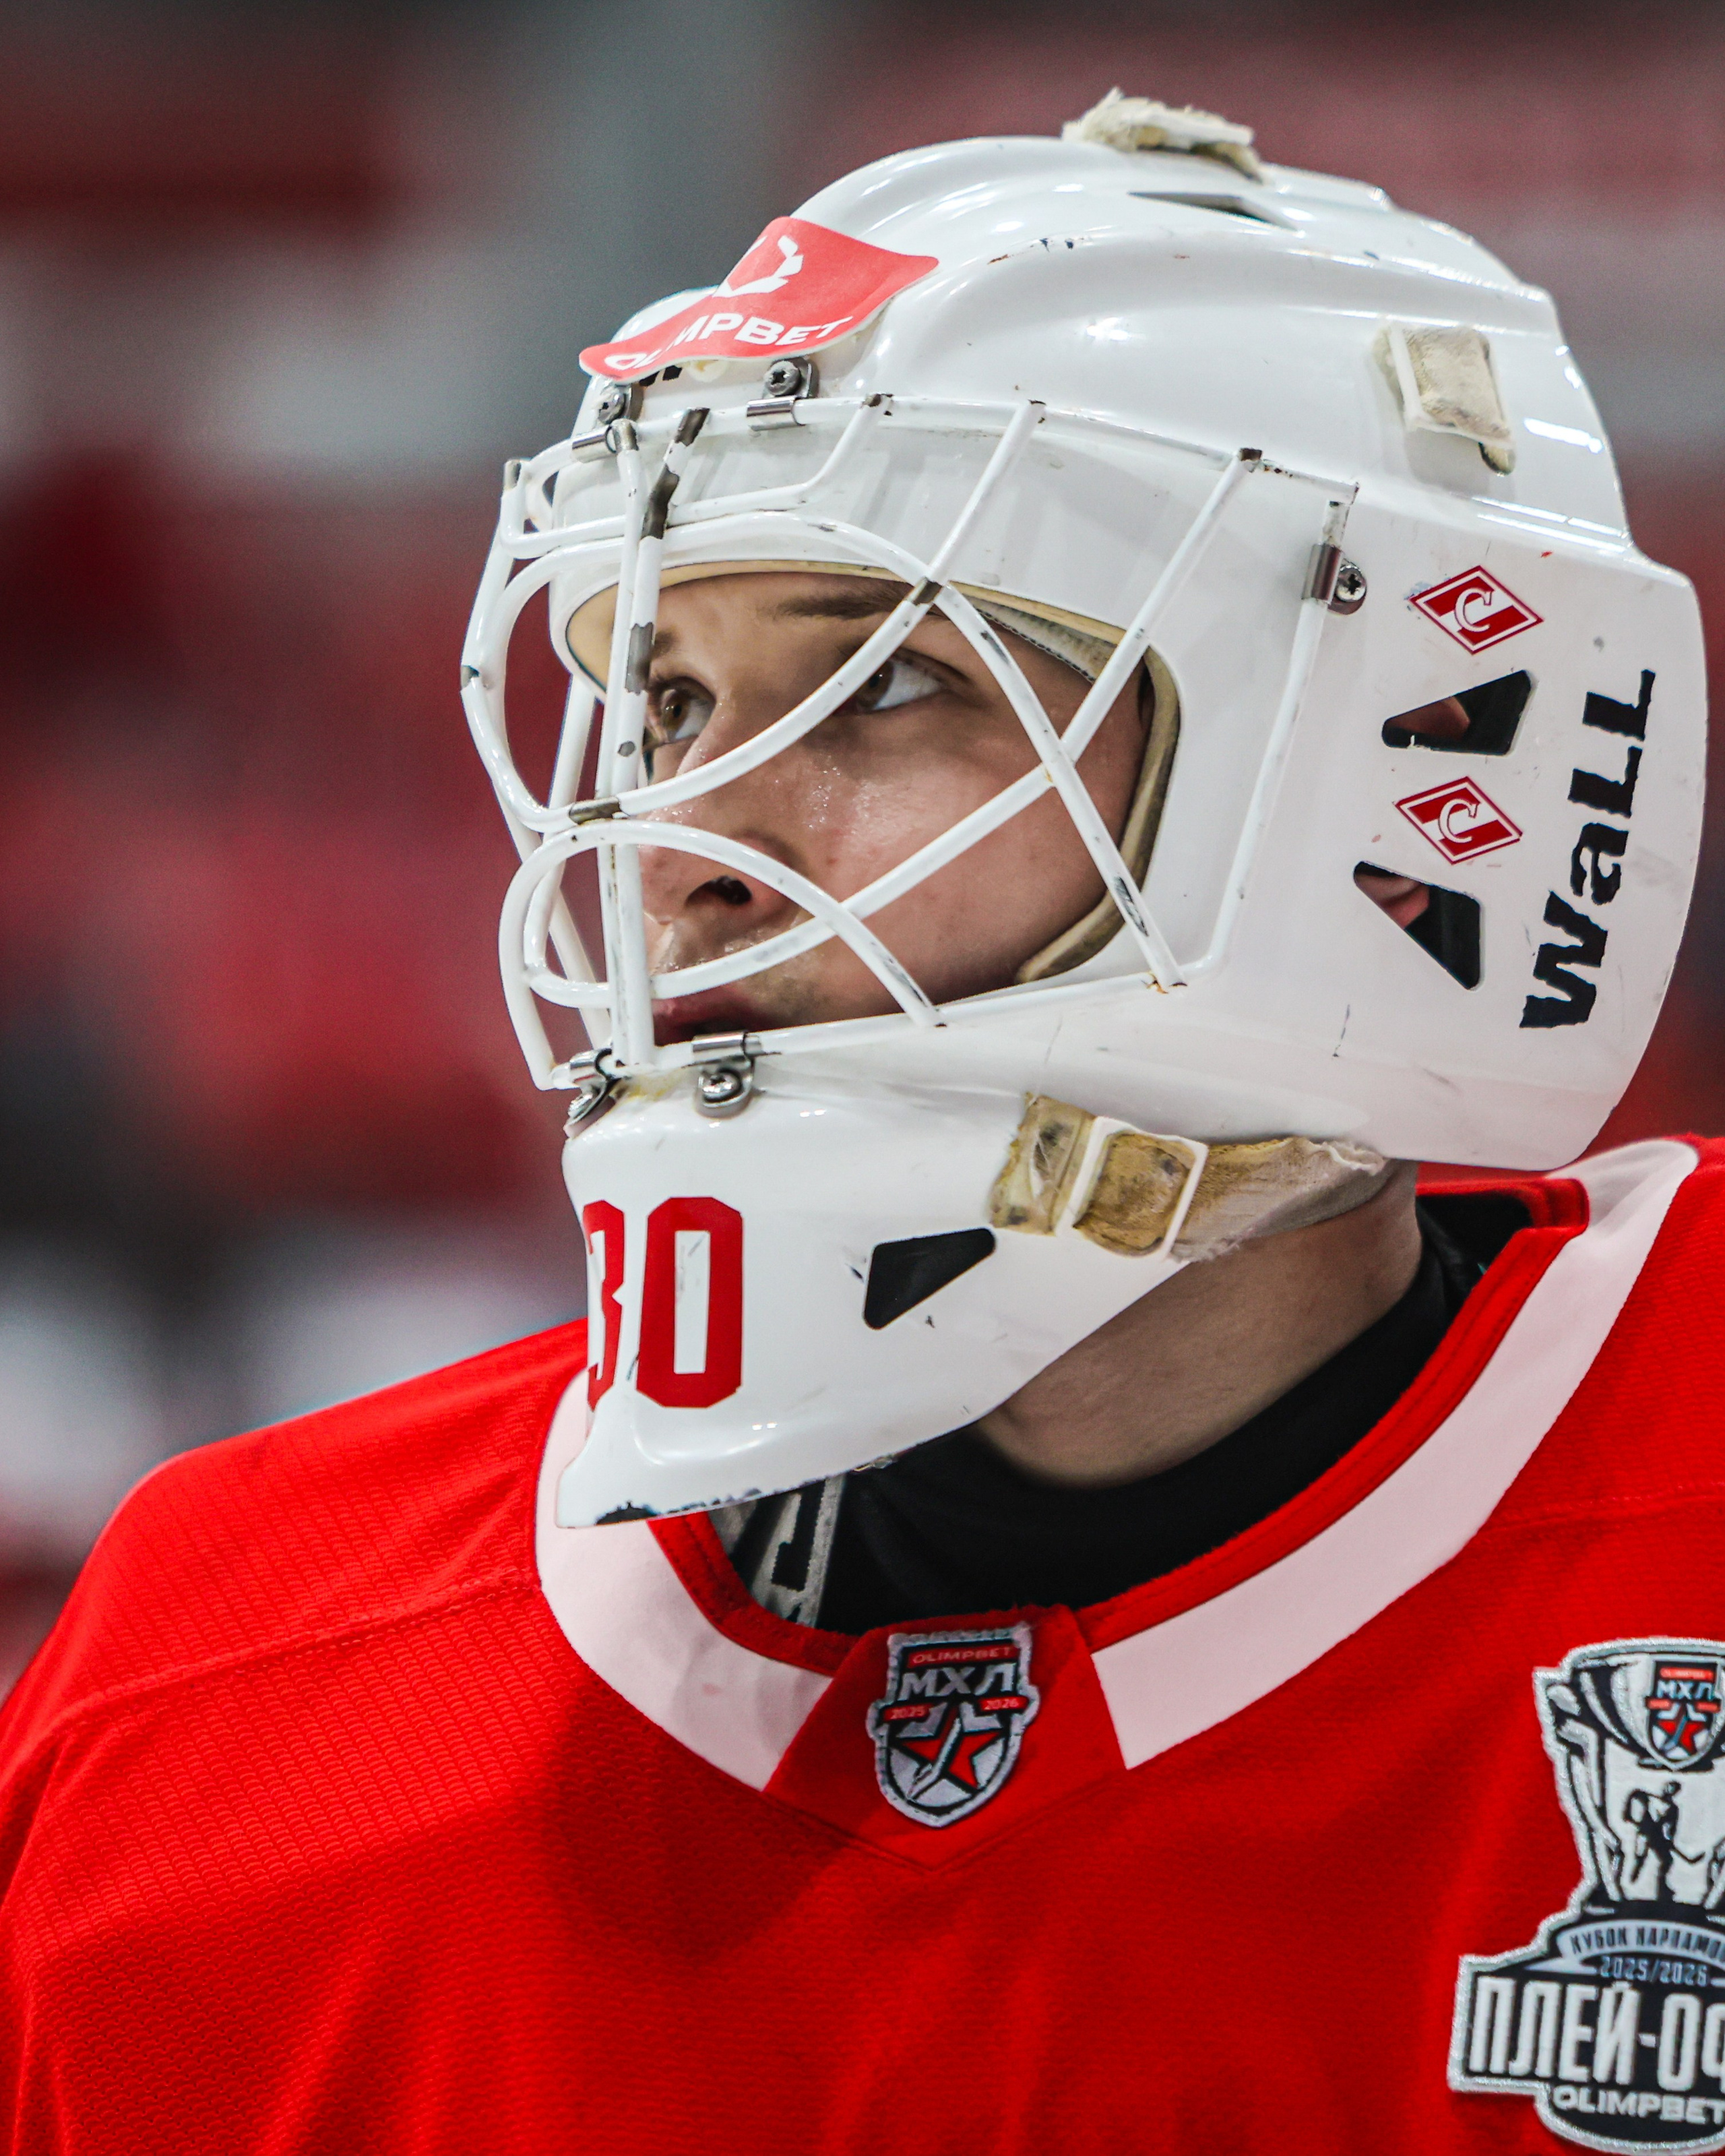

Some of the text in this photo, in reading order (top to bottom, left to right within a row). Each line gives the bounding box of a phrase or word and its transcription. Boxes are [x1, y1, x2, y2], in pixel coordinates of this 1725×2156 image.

[583, 1196, 743, 1412] 30
[912, 1646, 1011, 1664] OLIMPBET
[897, 1662, 1017, 1701] МХЛ
[1657, 1679, 1713, 1700] МХЛ
[1600, 1955, 1707, 1987] 2025/2026
